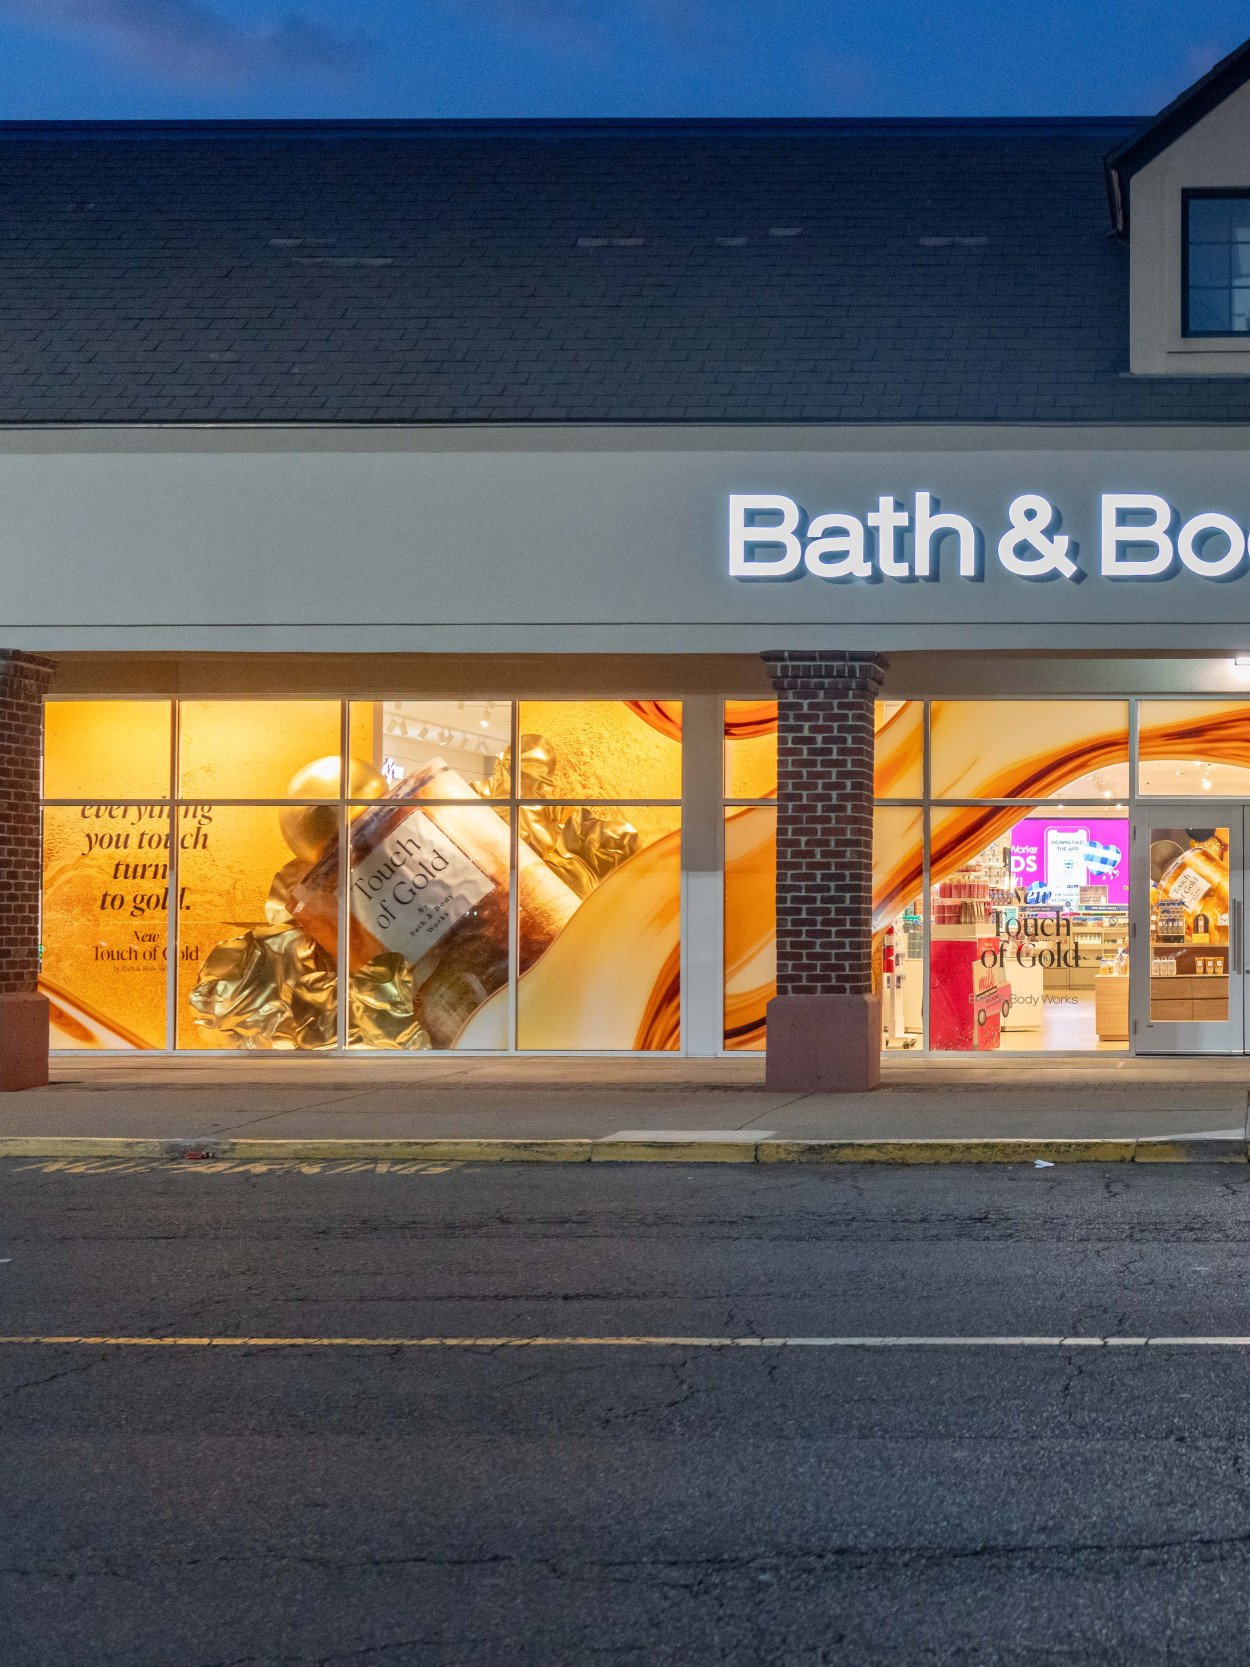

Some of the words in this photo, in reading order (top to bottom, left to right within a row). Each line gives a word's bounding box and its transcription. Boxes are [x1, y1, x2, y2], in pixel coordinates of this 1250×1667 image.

[727, 492, 976, 578] Bath
[998, 492, 1078, 578] &
[82, 832, 130, 855] you
[113, 860, 168, 880] turn
[350, 838, 422, 900] Touch
[376, 899, 398, 929] of
[392, 848, 450, 905] Gold
[1011, 888, 1052, 905] New
[100, 890, 125, 910] to
[988, 910, 1071, 937] Touch
[132, 930, 160, 943] New
[92, 945, 138, 960] Touch
[142, 945, 159, 960] of
[980, 941, 1010, 968] of
[1016, 941, 1080, 968] Gold
[1011, 994, 1040, 1006] Body
[1042, 994, 1078, 1004] Works
